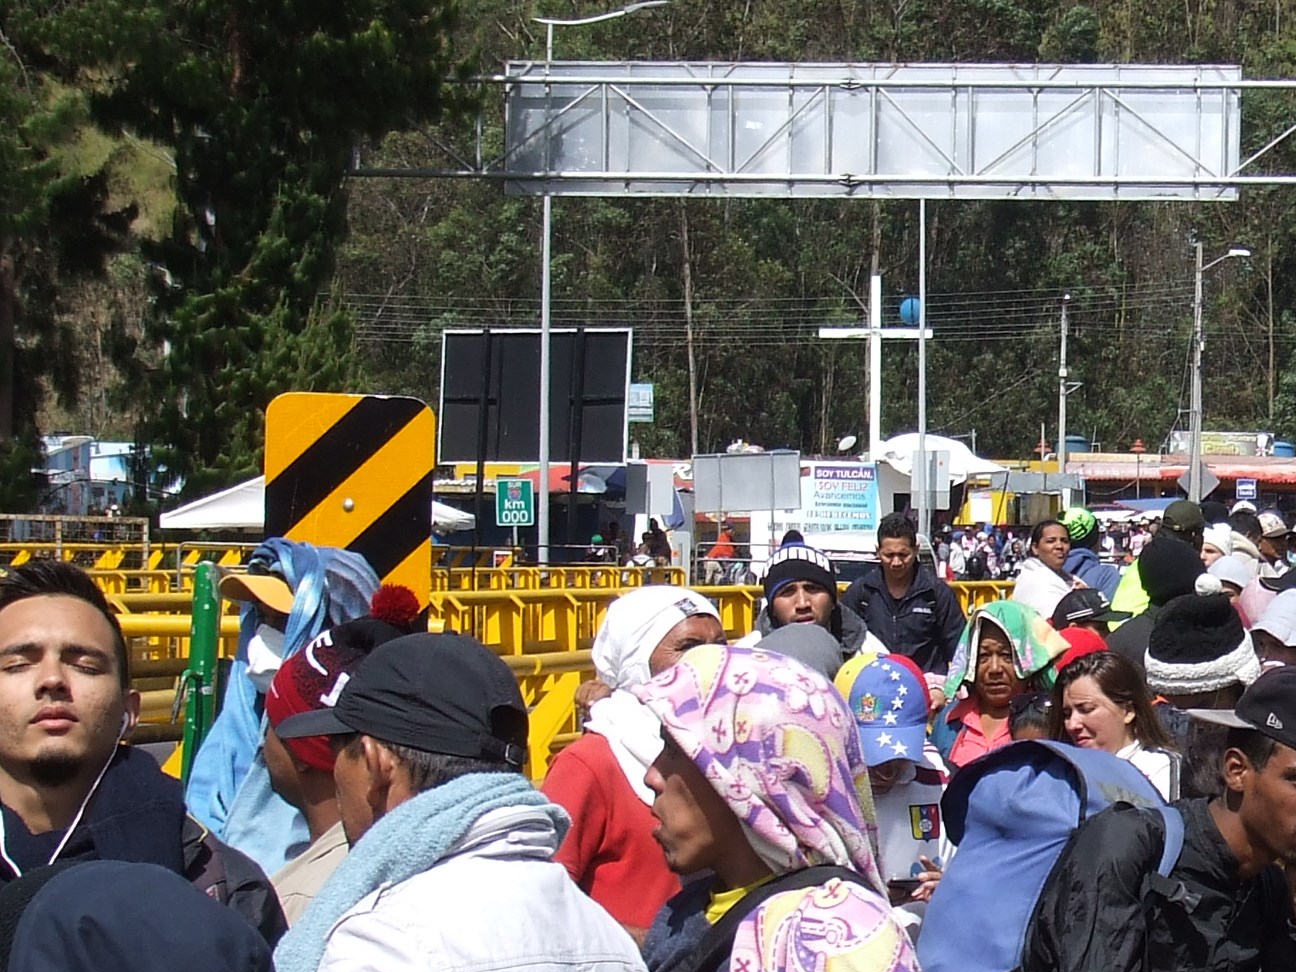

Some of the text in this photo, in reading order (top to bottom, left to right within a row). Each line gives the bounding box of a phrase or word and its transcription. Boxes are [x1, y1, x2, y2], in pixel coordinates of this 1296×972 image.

[816, 469, 834, 478] SOY
[504, 498, 525, 510] km
[502, 510, 528, 523] 000
